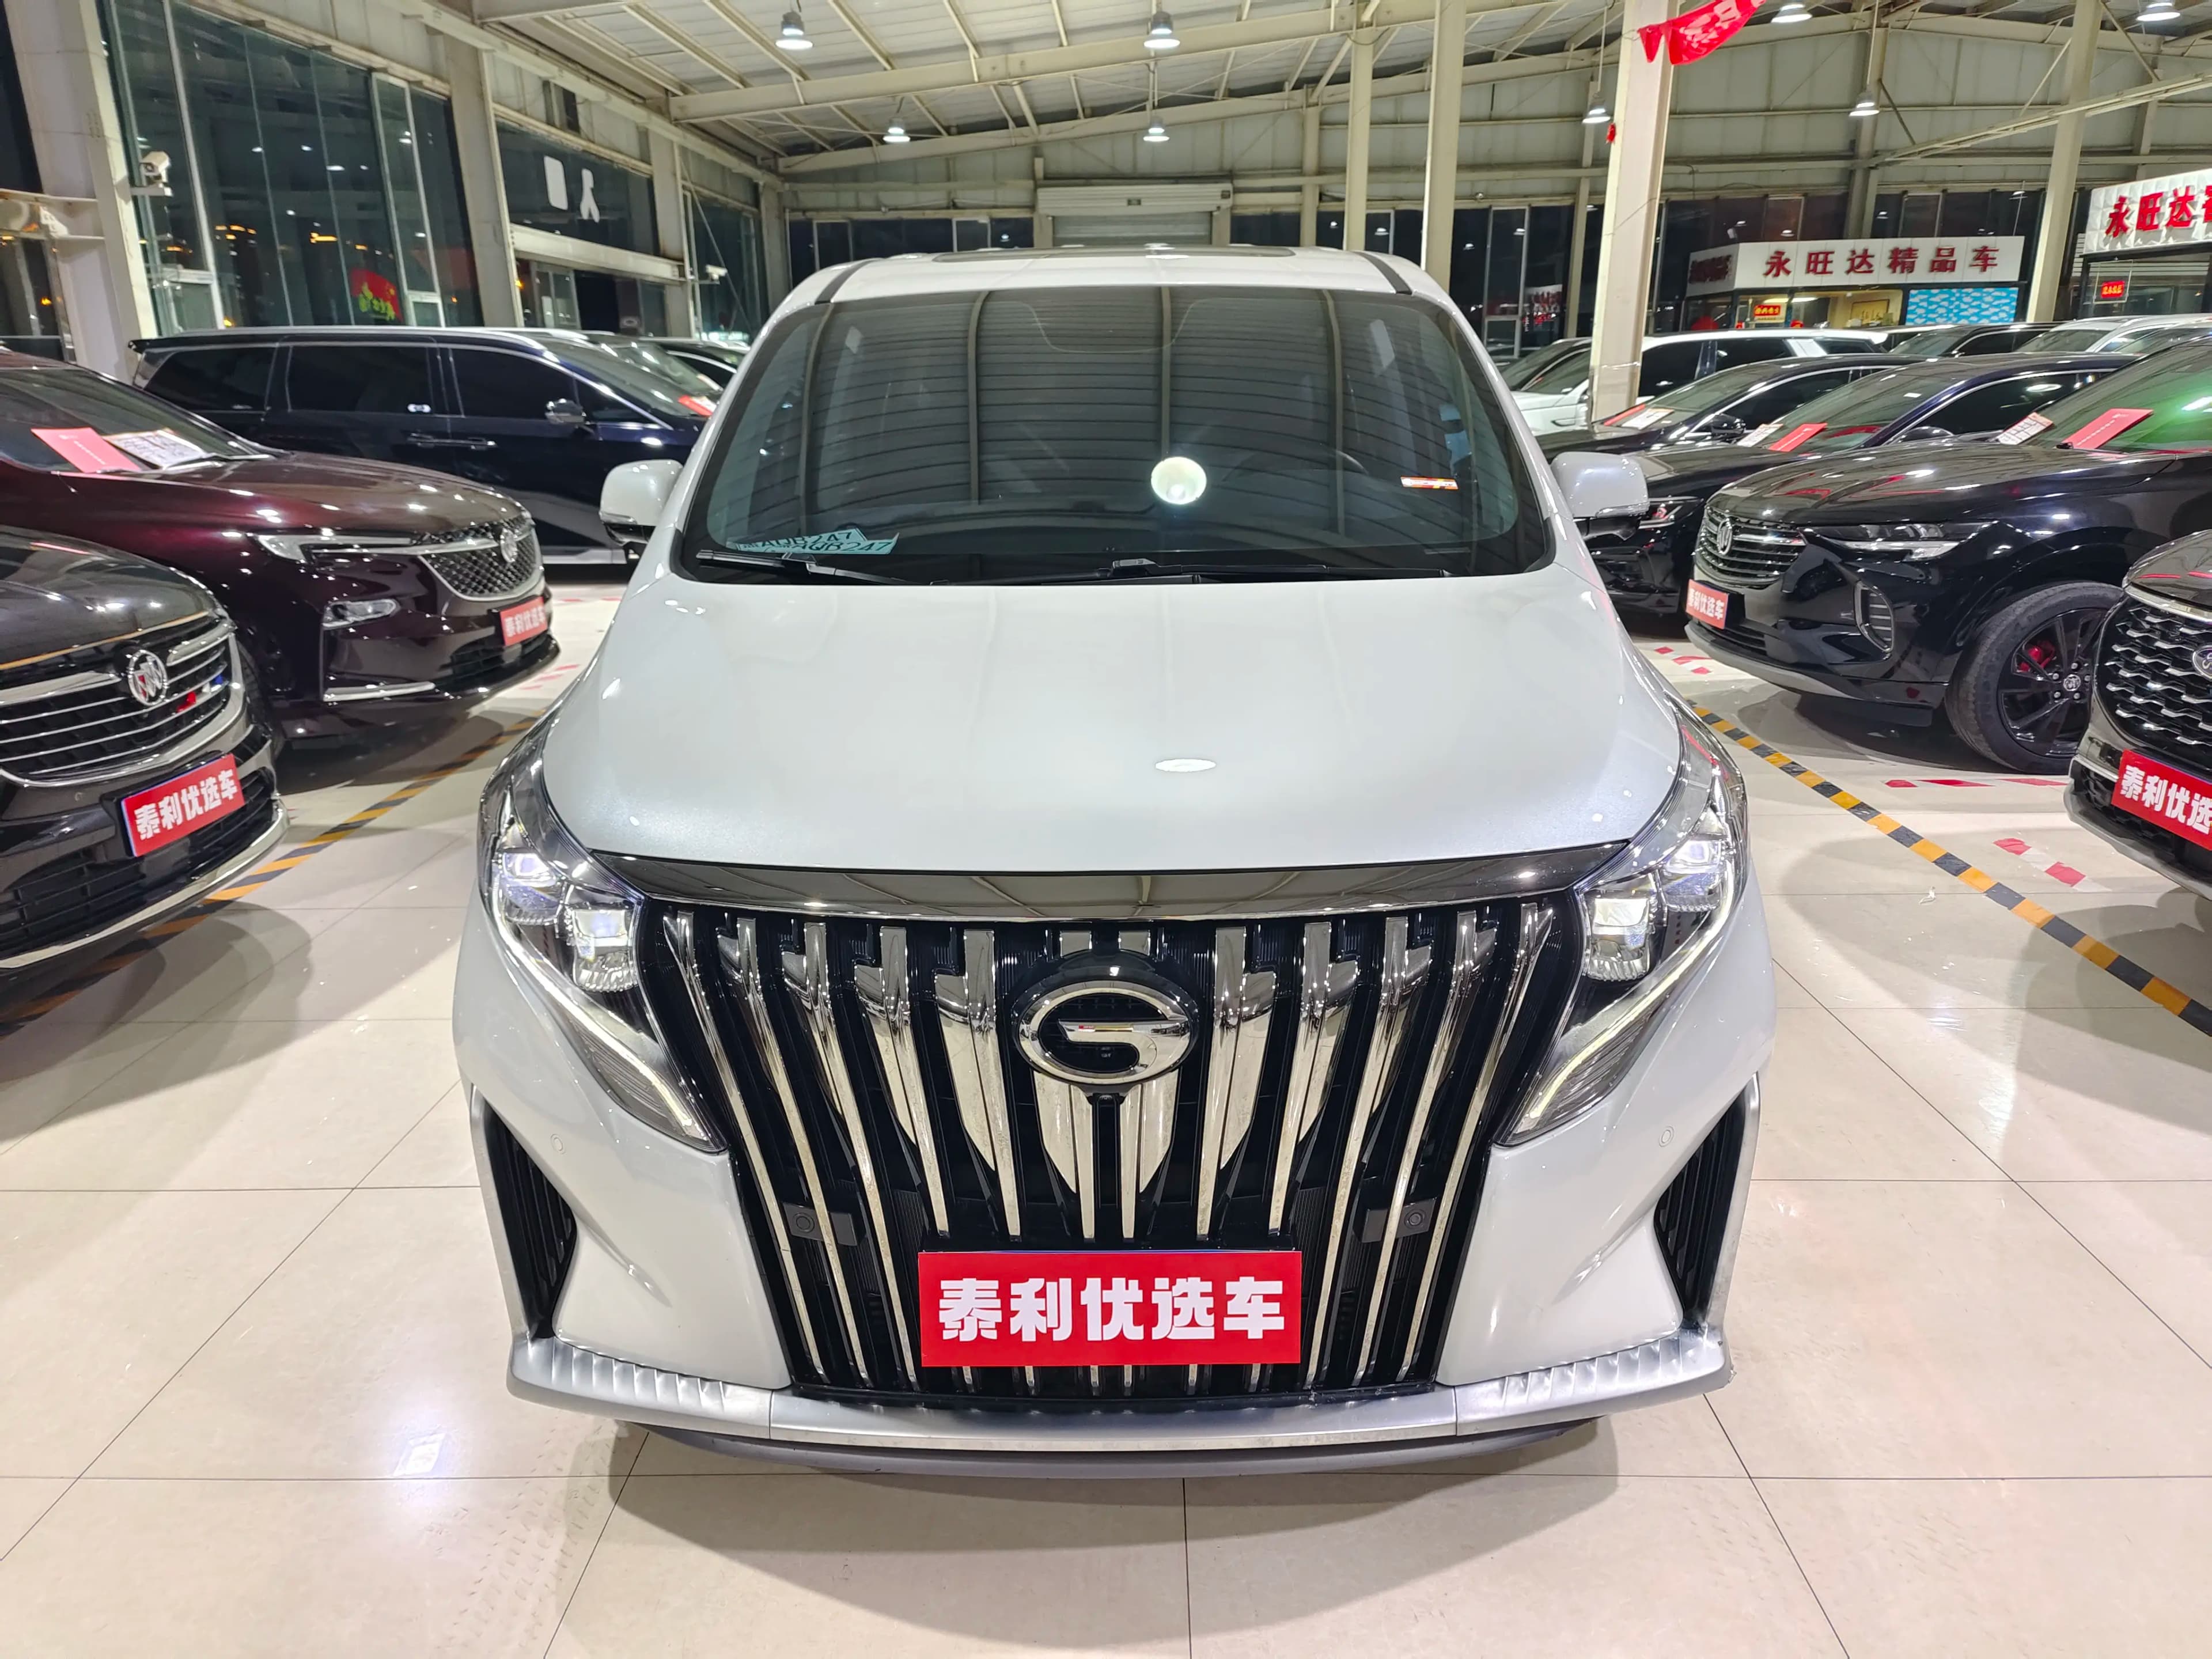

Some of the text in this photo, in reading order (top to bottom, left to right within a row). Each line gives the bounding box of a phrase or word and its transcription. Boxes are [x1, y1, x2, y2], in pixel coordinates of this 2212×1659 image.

[1763, 245, 1999, 278] 永旺达精品车
[134, 768, 238, 840] 泰利优选车
[938, 1275, 1285, 1342] 泰利优选车
